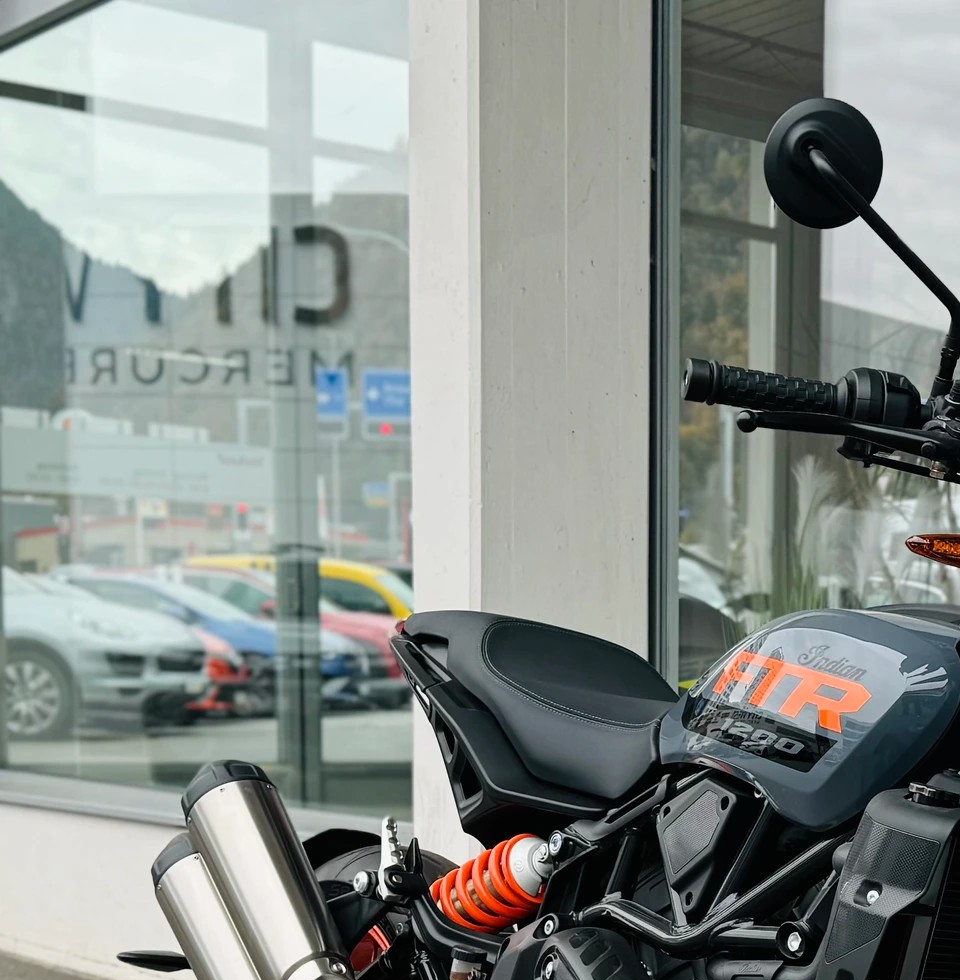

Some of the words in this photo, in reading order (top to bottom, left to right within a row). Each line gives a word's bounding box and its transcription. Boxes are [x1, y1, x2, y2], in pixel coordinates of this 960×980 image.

[797, 644, 868, 682] Indian
[712, 649, 872, 734] FTR
[720, 717, 805, 756] 1200
